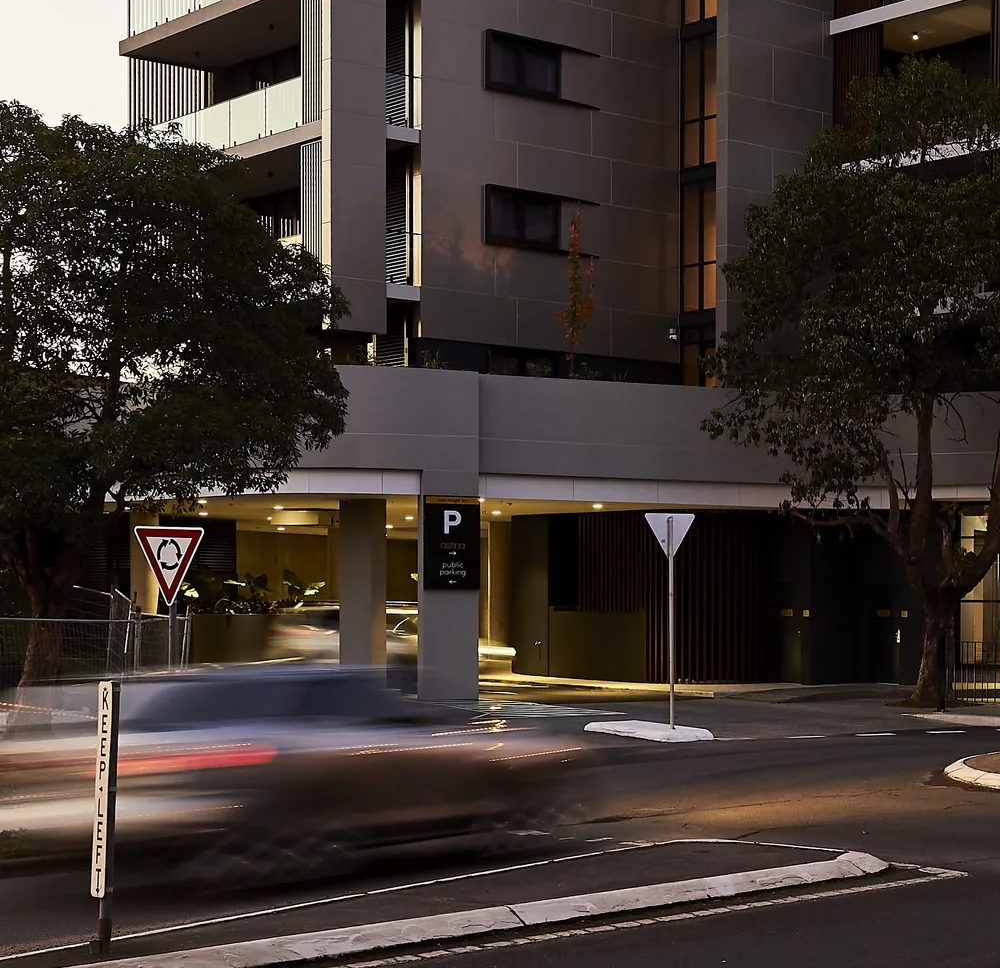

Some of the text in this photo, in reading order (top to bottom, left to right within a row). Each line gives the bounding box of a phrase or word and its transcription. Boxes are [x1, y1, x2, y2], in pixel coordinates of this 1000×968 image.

[443, 510, 462, 534] P
[440, 542, 466, 550] astina
[442, 561, 464, 570] public
[439, 568, 467, 578] parking
[95, 690, 109, 889] KEEP LEFT
